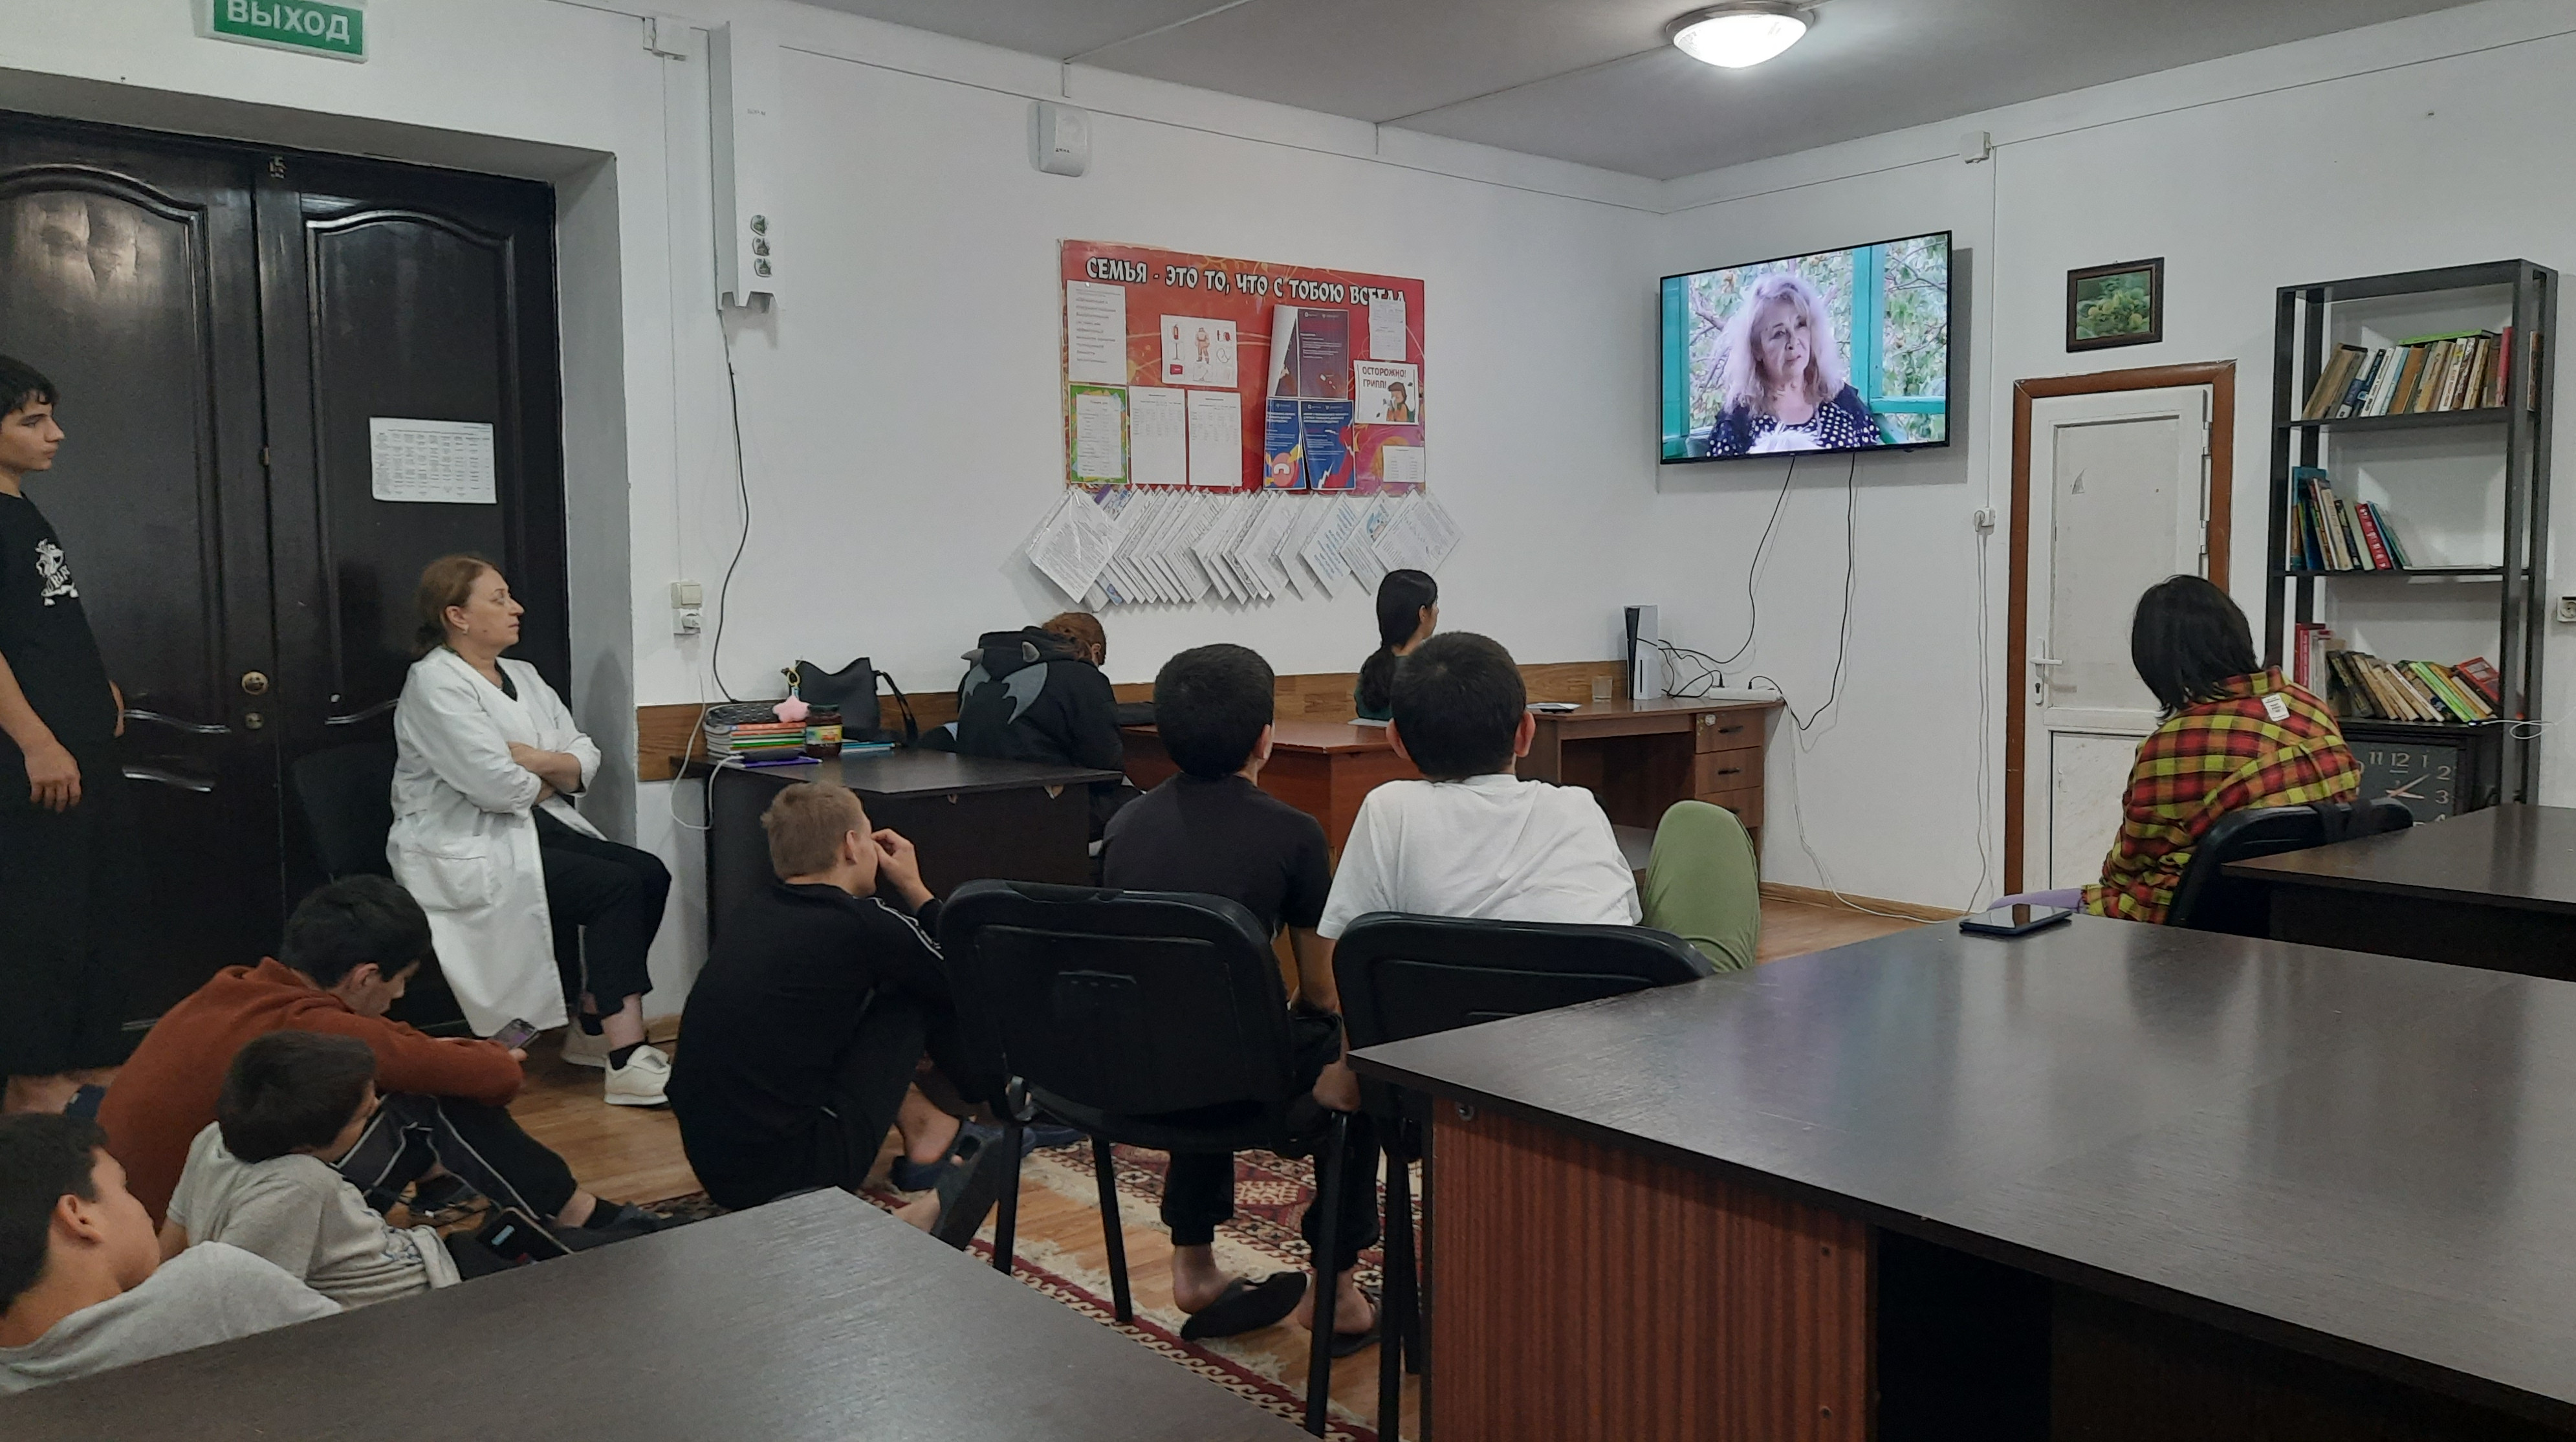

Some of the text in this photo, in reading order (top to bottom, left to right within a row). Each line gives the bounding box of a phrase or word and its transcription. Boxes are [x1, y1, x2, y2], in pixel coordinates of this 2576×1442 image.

[227, 0, 350, 45] ВЫХОД
[1086, 257, 1148, 283] СЕМЬЯ
[1165, 265, 1198, 289] ЭТО
[1204, 270, 1230, 294] ТО,
[1235, 273, 1269, 296] ЧТО
[1274, 277, 1283, 297] С
[1289, 279, 1344, 303] ТОБОЮ
[1362, 366, 1406, 378] ОСТОРОЖНО!
[1362, 379, 1387, 389] ГРИПП!
[2368, 750, 2428, 768] 11 12 1
[2437, 765, 2451, 780] 2
[2435, 789, 2449, 804] 3
